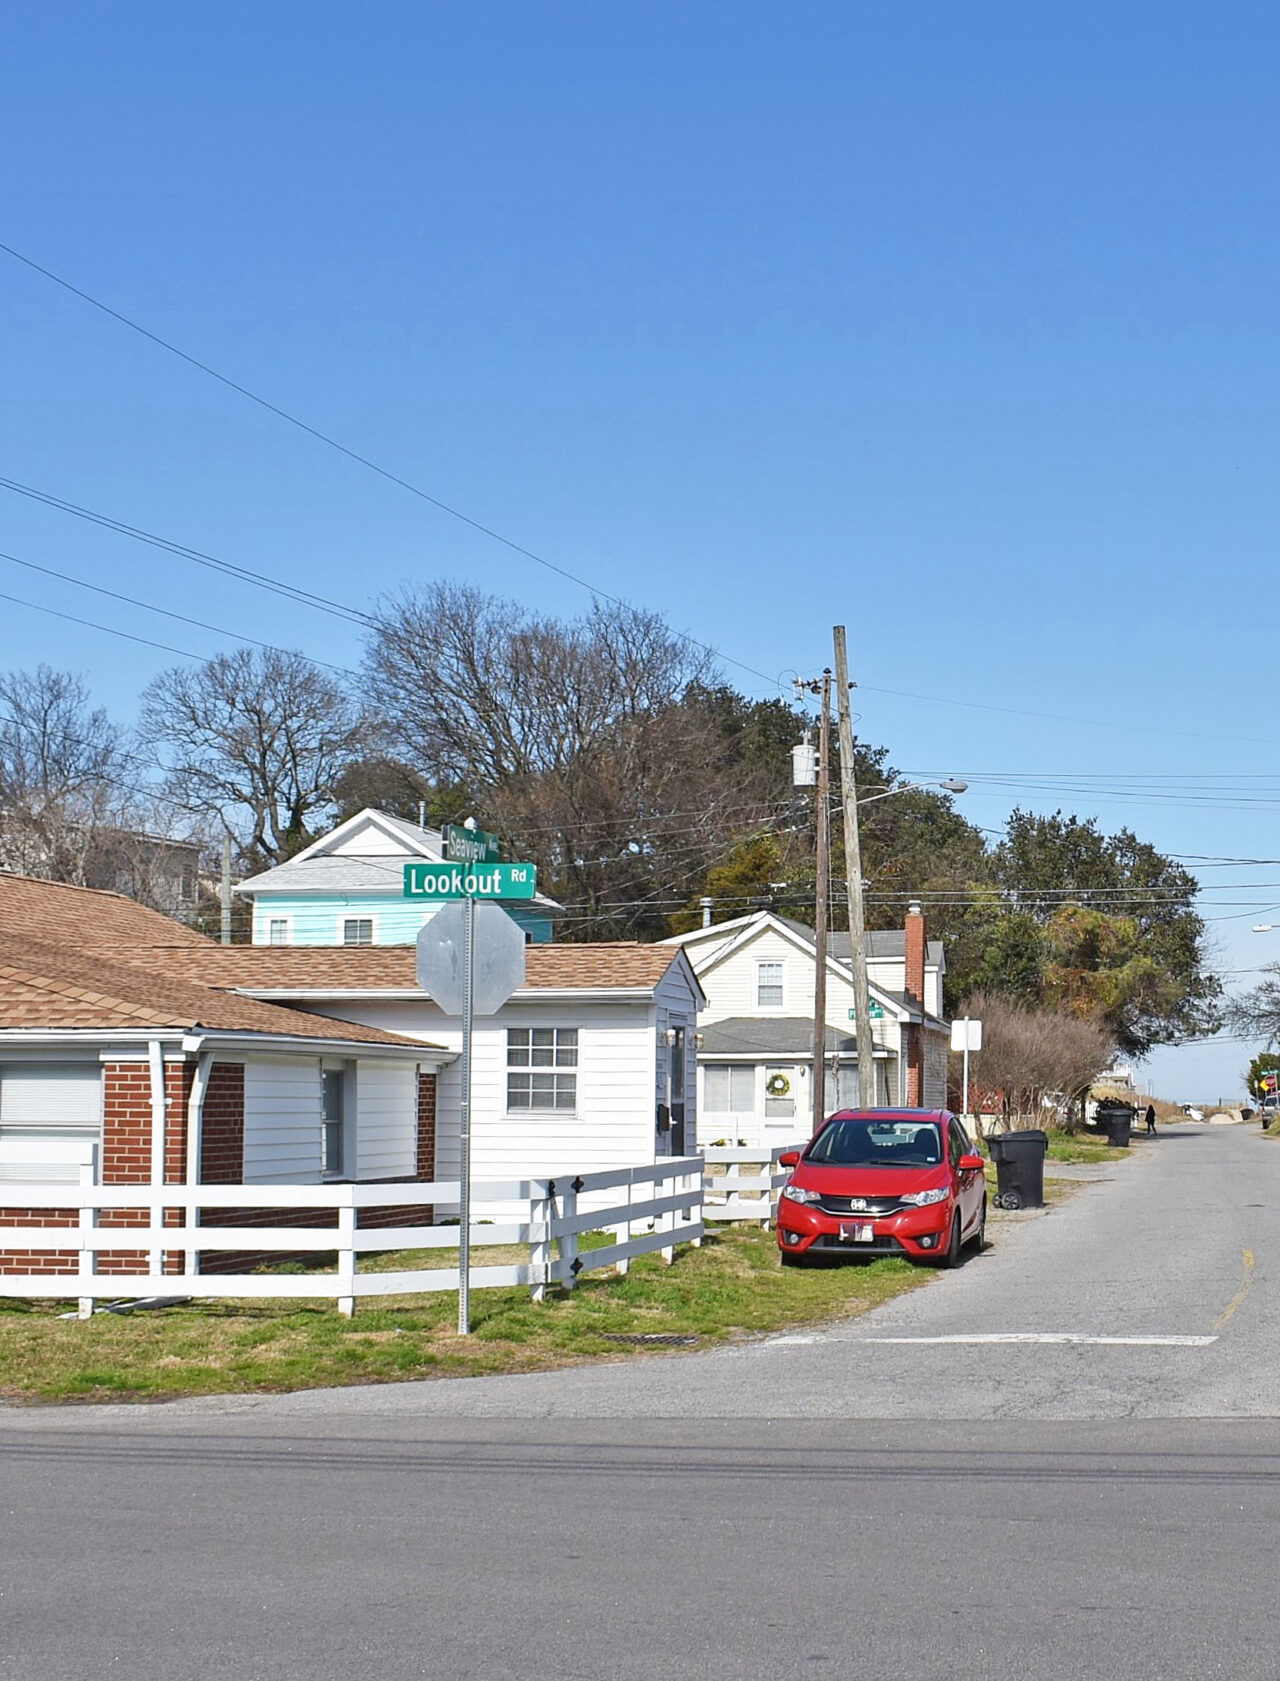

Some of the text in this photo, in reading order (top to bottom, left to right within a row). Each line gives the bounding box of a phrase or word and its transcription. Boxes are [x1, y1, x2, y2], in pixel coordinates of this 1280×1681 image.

[450, 830, 487, 860] Seaview
[411, 869, 526, 893] Lookout Rd
